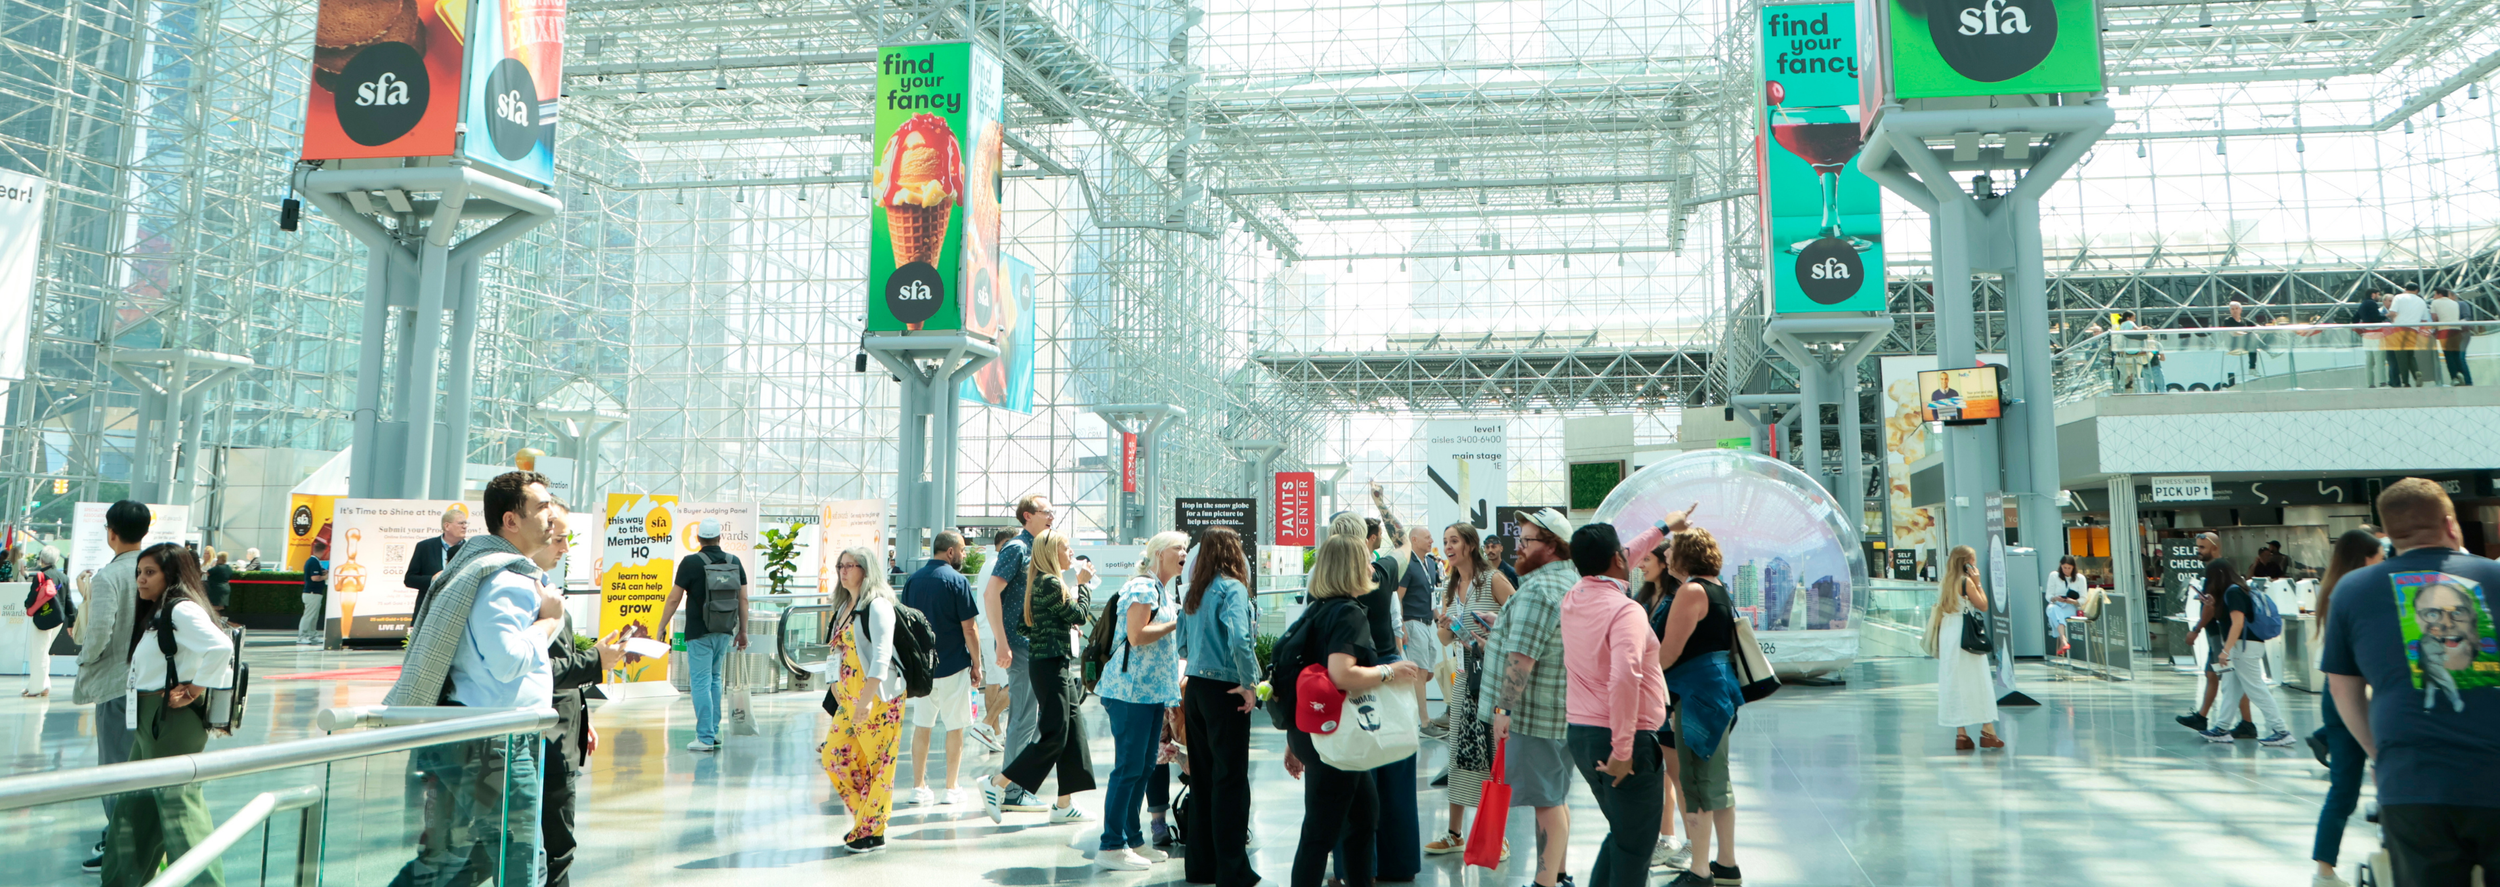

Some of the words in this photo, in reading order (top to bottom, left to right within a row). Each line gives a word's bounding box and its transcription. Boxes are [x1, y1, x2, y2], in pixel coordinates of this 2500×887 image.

[1958, 0, 2032, 36] sfa
[1768, 13, 1828, 37] find
[1791, 37, 1842, 55] your
[883, 53, 934, 75] find
[974, 54, 992, 85] find
[1777, 53, 1858, 78] fancy
[355, 72, 410, 106] sfa
[901, 76, 944, 93] your
[887, 90, 961, 114] fancy
[496, 89, 529, 127] sfa
[0, 186, 33, 203] ear!
[1811, 257, 1851, 280] sfa
[898, 280, 932, 300] sfa
[977, 286, 989, 307] sfa
[1474, 425, 1496, 433] level
[1497, 425, 1502, 433] 1
[1431, 436, 1455, 444] aisles
[1456, 435, 1502, 444] 3400-6400
[1452, 452, 1474, 460] main
[1476, 452, 1502, 461] stage
[1494, 462, 1502, 470] 1E
[550, 481, 568, 489] tration
[2155, 487, 2183, 496] PICK
[2186, 486, 2201, 496] UP
[1182, 502, 1195, 510] Hop
[1232, 502, 1249, 510] globe
[1282, 481, 1294, 536] JAVITS
[1299, 481, 1309, 536] CENTER
[390, 508, 413, 516] Shine
[1213, 510, 1236, 518] picture
[608, 516, 624, 525] this
[626, 516, 644, 525] way
[651, 516, 667, 528] sfa
[776, 516, 820, 525] STARBU
[1187, 518, 1201, 526] help
[629, 525, 644, 533] the
[720, 521, 733, 532] ofi
[607, 533, 672, 547] Membership
[720, 531, 749, 540] wards
[631, 546, 650, 558] HQ
[724, 542, 748, 551] 2026
[2172, 546, 2199, 556] SELF
[1105, 561, 1135, 569] spotlight
[2169, 559, 2205, 569] CHECK
[618, 572, 639, 580] learn
[641, 572, 658, 580] how
[611, 582, 627, 590] SFA
[645, 582, 663, 591] help
[607, 594, 626, 603] your
[628, 593, 666, 602] company
[619, 604, 652, 617] grow
[1759, 643, 1776, 654] 26
